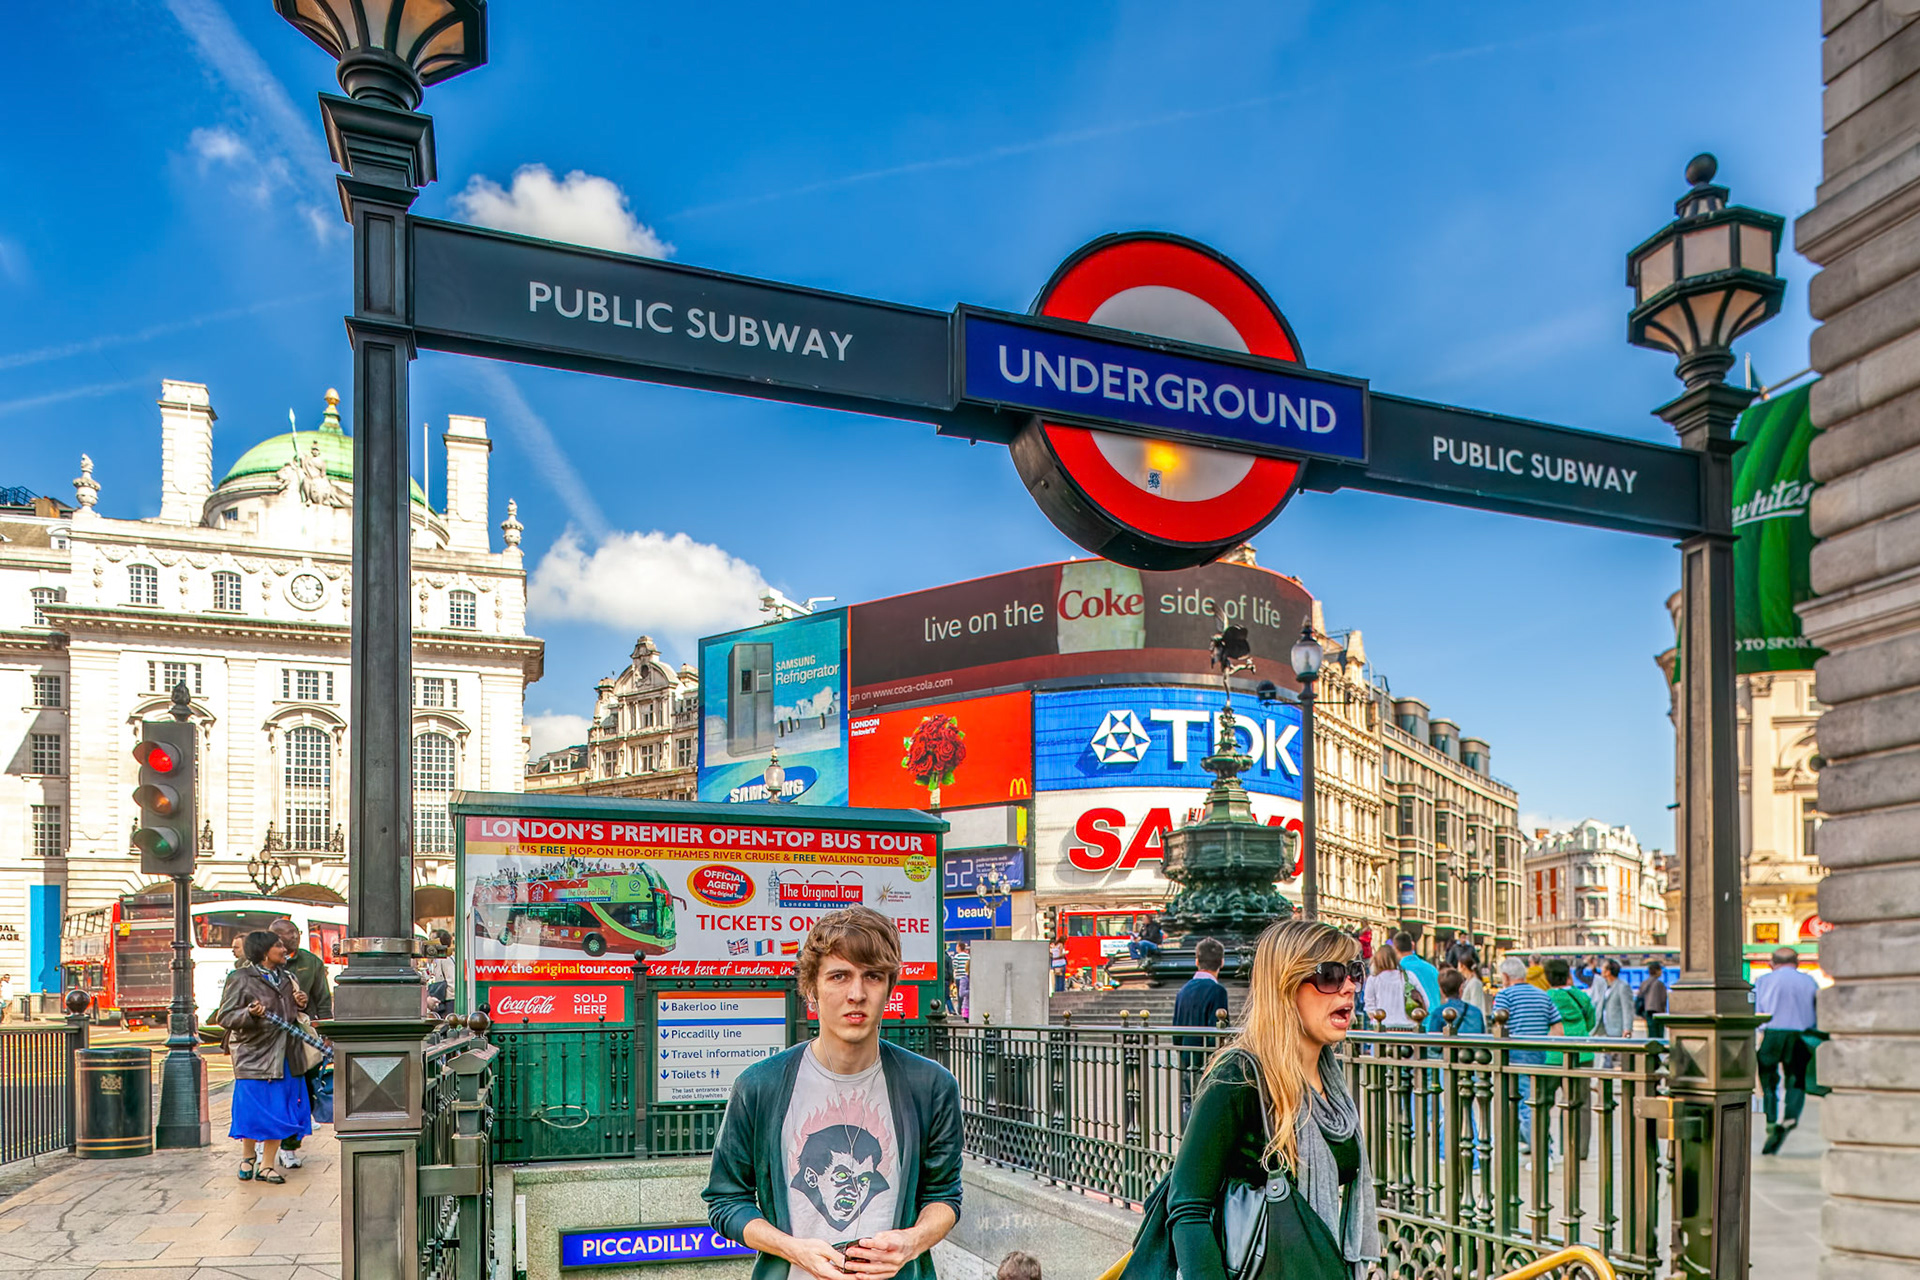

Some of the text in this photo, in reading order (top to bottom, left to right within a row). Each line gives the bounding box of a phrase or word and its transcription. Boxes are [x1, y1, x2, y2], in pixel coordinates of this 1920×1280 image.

[529, 281, 853, 361] PUBLIC SUBWAY
[999, 345, 1336, 434] UNDERGROUND
[1433, 436, 1637, 494] PUBLIC SUBWAY
[924, 587, 1281, 642] live on the Coke side of life
[1742, 637, 1765, 651] TO
[775, 655, 816, 672] SAMSUNG
[775, 663, 840, 685] Refrigerator
[861, 691, 871, 700] on
[873, 678, 953, 698] www.coca-cola.com
[851, 718, 880, 730] LONDON
[1150, 708, 1301, 776] TDK
[730, 779, 804, 804] SAMSNG
[481, 819, 923, 852] LONDON'S PREMIER OPEN-TOP BUS TOUR
[508, 844, 899, 865] PLUS FREE HOP-ON HOP-OFF THAMES RIVER CRUISE & FREE WALKING TOURS
[703, 869, 746, 883] OFFICIAL
[945, 859, 973, 887] 52
[707, 880, 740, 892] AGENT
[783, 883, 860, 901] The Original Tour
[957, 906, 993, 919] beauty
[696, 914, 782, 932] TICKETS
[475, 963, 634, 977] www.theoriginaltour.com
[671, 960, 691, 975] the
[694, 960, 718, 975] best
[719, 961, 732, 975] of
[497, 994, 607, 1015] Coca-Cola SOLD
[574, 1005, 607, 1015] HERE
[671, 1002, 739, 1012] Bakerloo line
[884, 1003, 904, 1012] ERE
[671, 1028, 742, 1040] Piccadilly line
[671, 1047, 766, 1059] Travel information
[671, 1068, 707, 1079] Toilets
[582, 1233, 704, 1258] PICCADILLY
